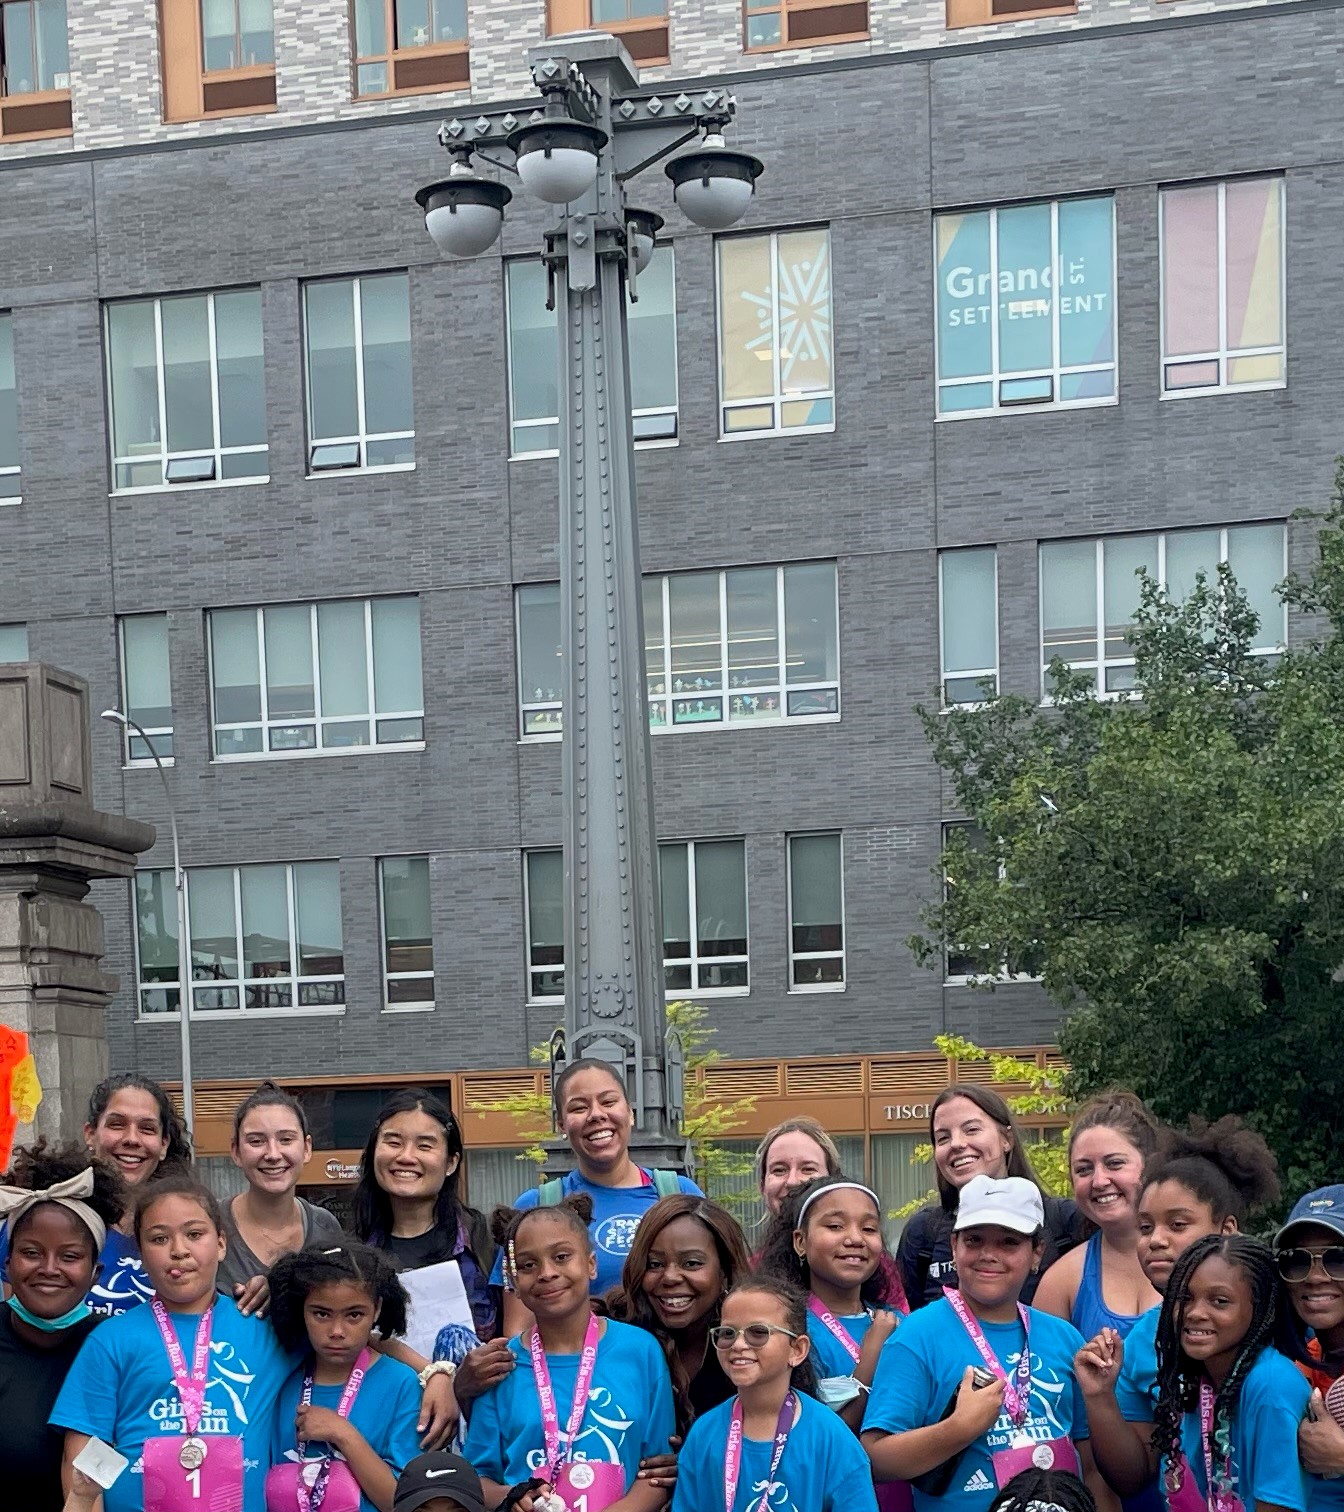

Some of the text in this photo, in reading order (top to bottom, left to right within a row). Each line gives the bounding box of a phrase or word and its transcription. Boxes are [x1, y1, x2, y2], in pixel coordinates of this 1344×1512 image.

[946, 254, 1064, 299] Grand
[213, 1408, 228, 1417] on
[160, 1420, 180, 1431] the
[1034, 1417, 1048, 1426] on
[986, 1434, 1007, 1447] the
[185, 1468, 201, 1499] 1
